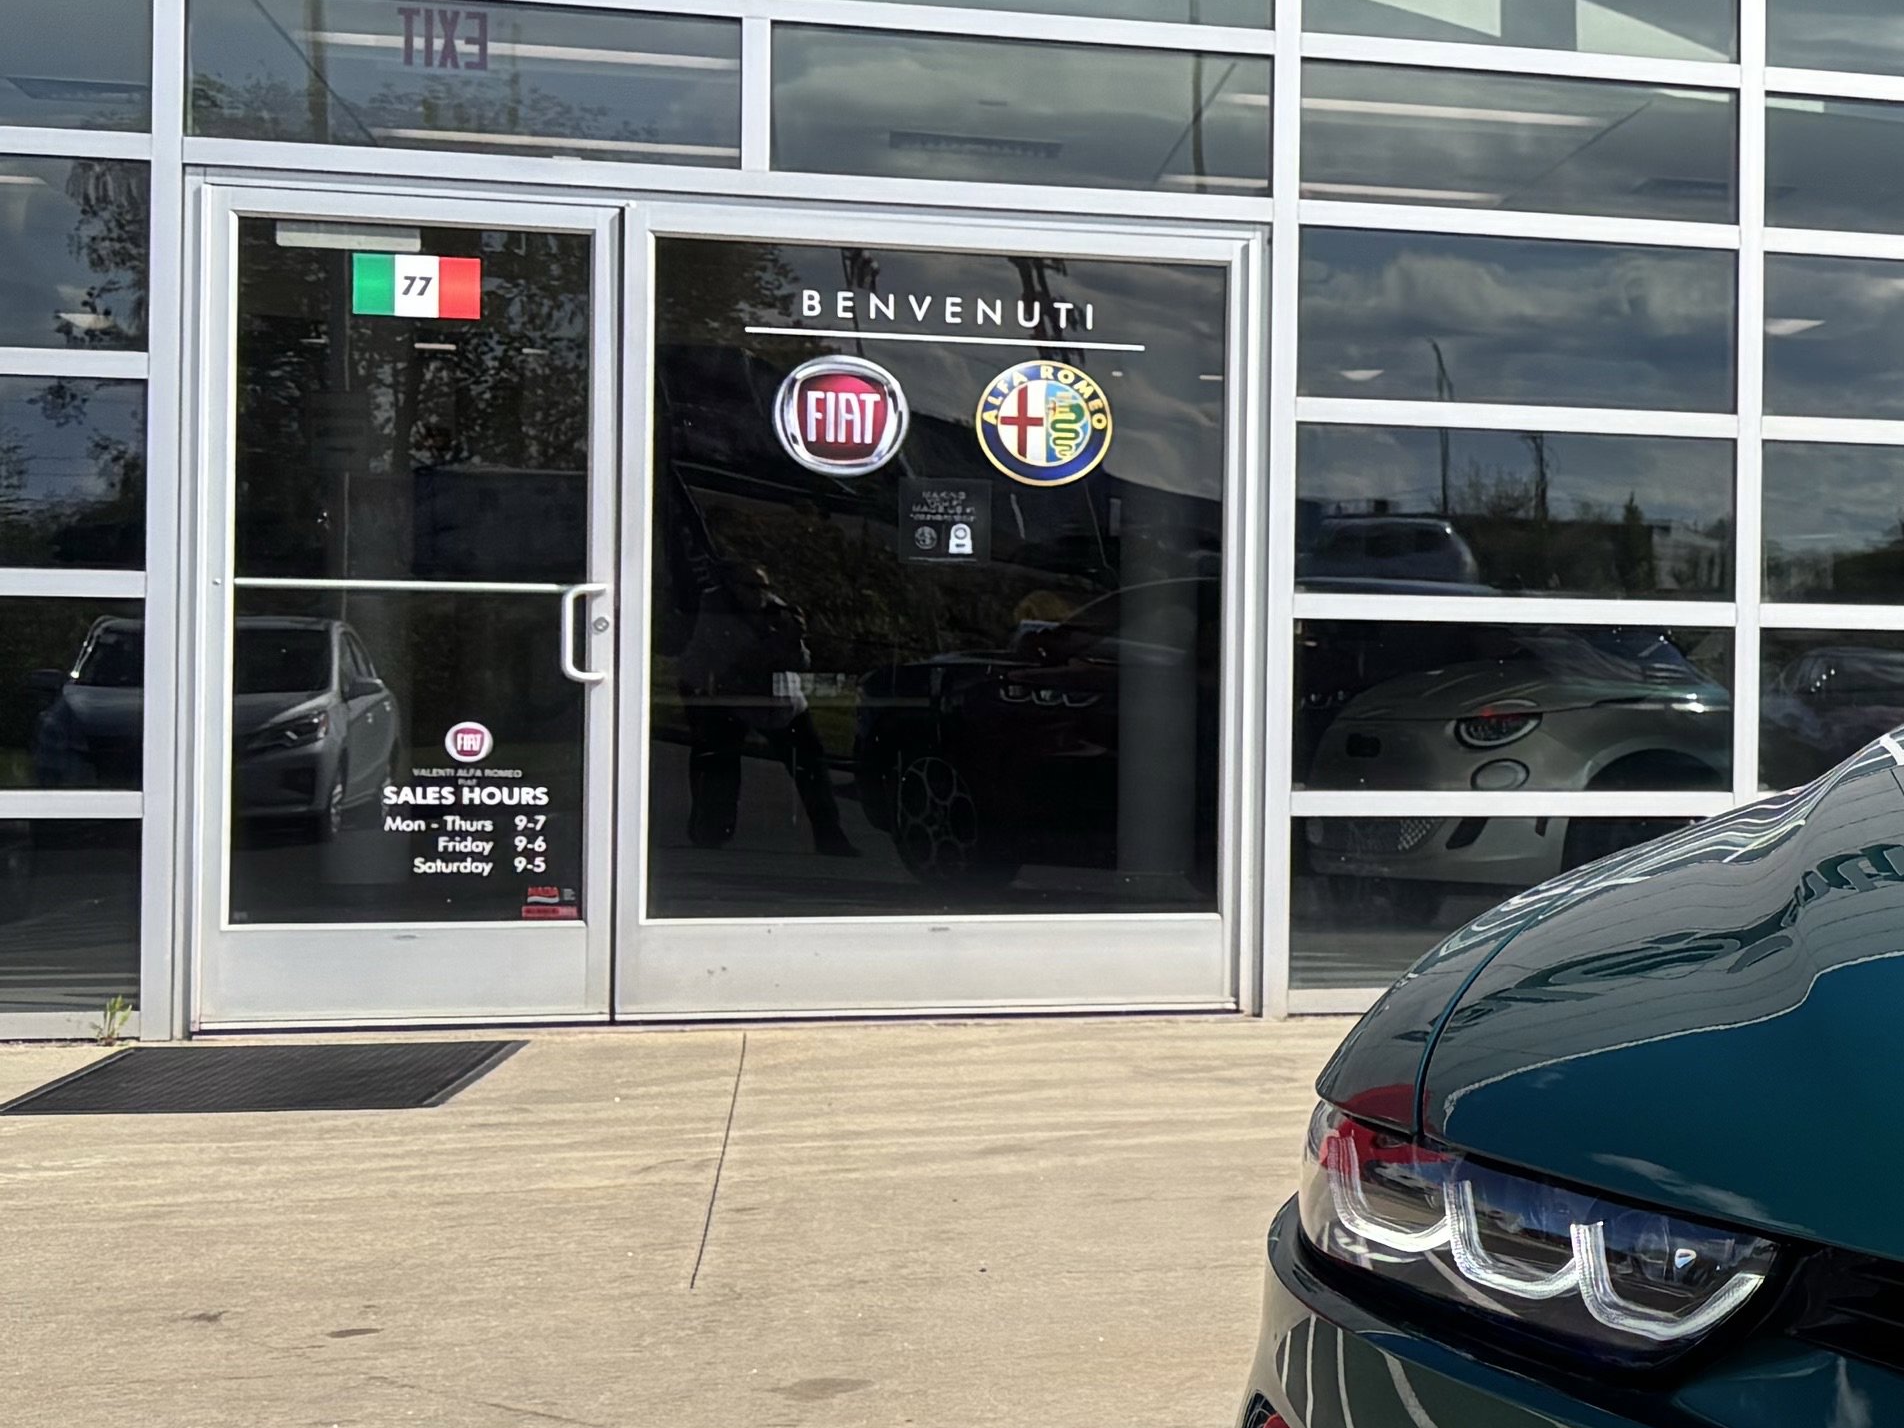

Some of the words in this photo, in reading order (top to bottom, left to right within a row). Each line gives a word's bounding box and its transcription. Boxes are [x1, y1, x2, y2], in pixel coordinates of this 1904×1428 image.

[402, 275, 433, 296] 77
[802, 289, 1094, 330] BENVENUTI
[983, 371, 1028, 426] ALFA
[1040, 365, 1107, 430] ROMEO
[806, 389, 882, 445] FIAT
[457, 733, 483, 751] FIAT
[412, 768, 455, 778] VALENTI
[456, 769, 483, 778] ALFA
[484, 769, 523, 779] ROMEO
[383, 786, 455, 805] SALES
[462, 786, 549, 805] HOURS
[384, 816, 426, 831] Mon
[443, 815, 494, 832] Thurs
[514, 815, 547, 831] 9-7
[438, 836, 494, 855] Friday
[514, 835, 547, 852] 9-6
[413, 857, 494, 876] Saturday
[513, 857, 547, 872] 9-5
